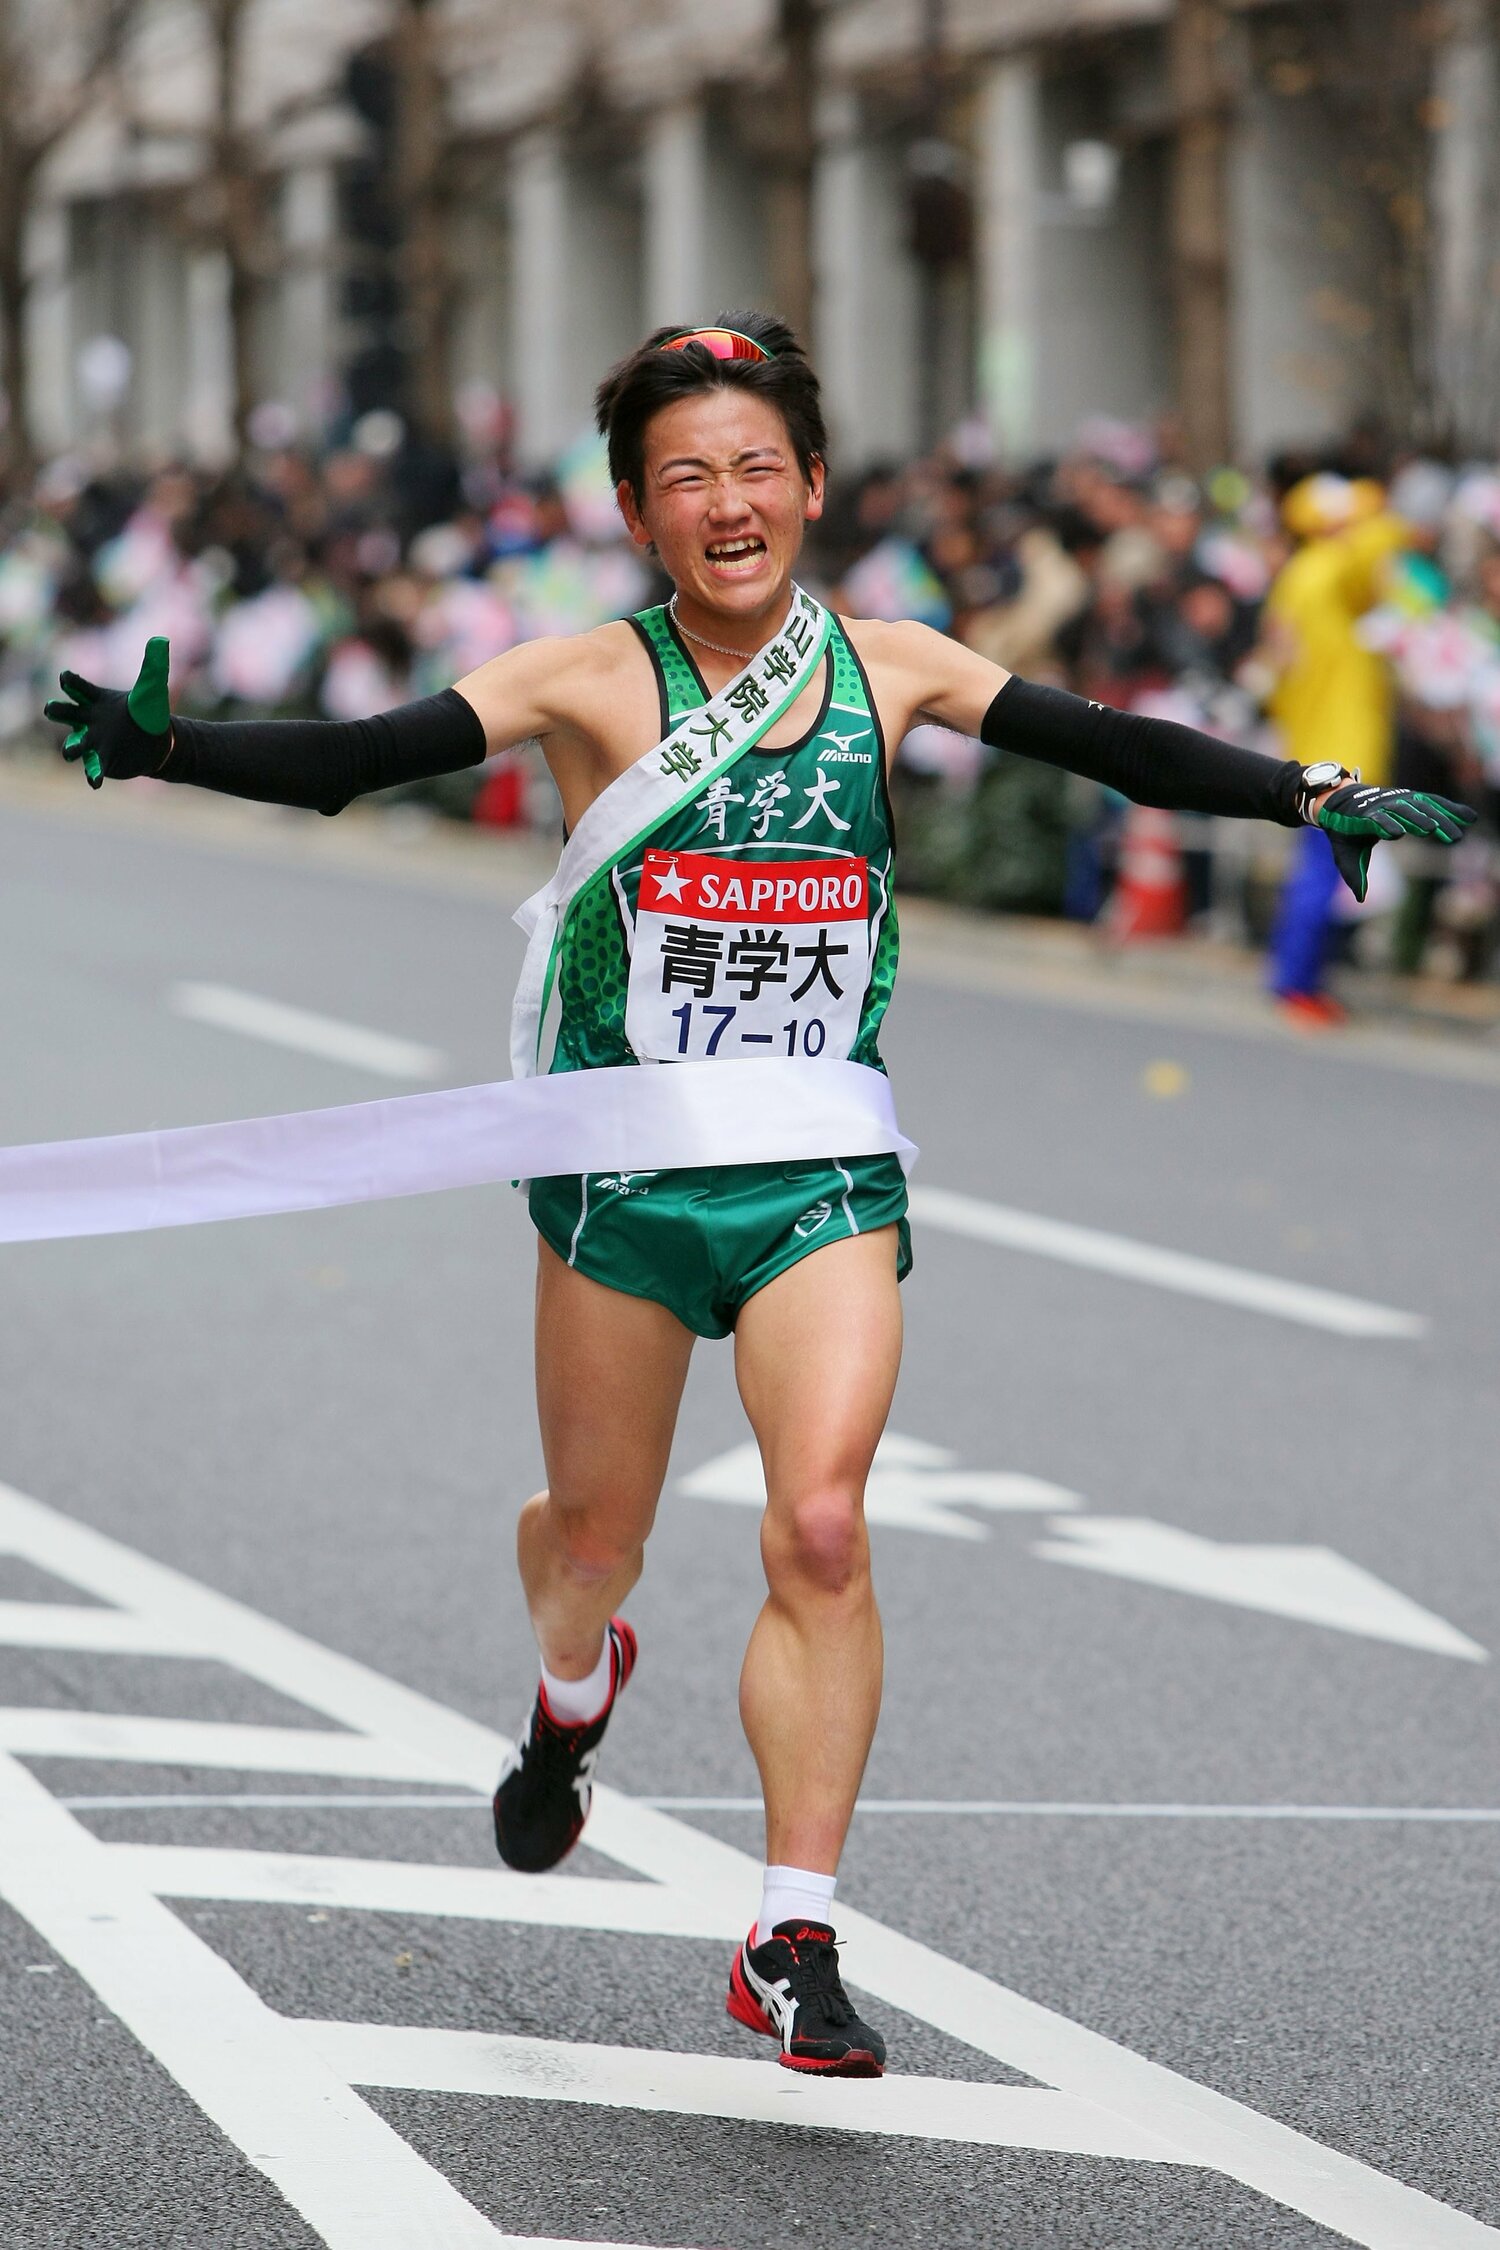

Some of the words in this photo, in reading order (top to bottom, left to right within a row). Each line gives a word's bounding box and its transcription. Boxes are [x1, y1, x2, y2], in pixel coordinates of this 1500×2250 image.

[817, 749, 872, 764] MIZUNO
[696, 767, 850, 840] 青学大
[698, 874, 862, 912] SAPPORO
[660, 925, 849, 1002] 青学大
[672, 1002, 826, 1057] 17-10
